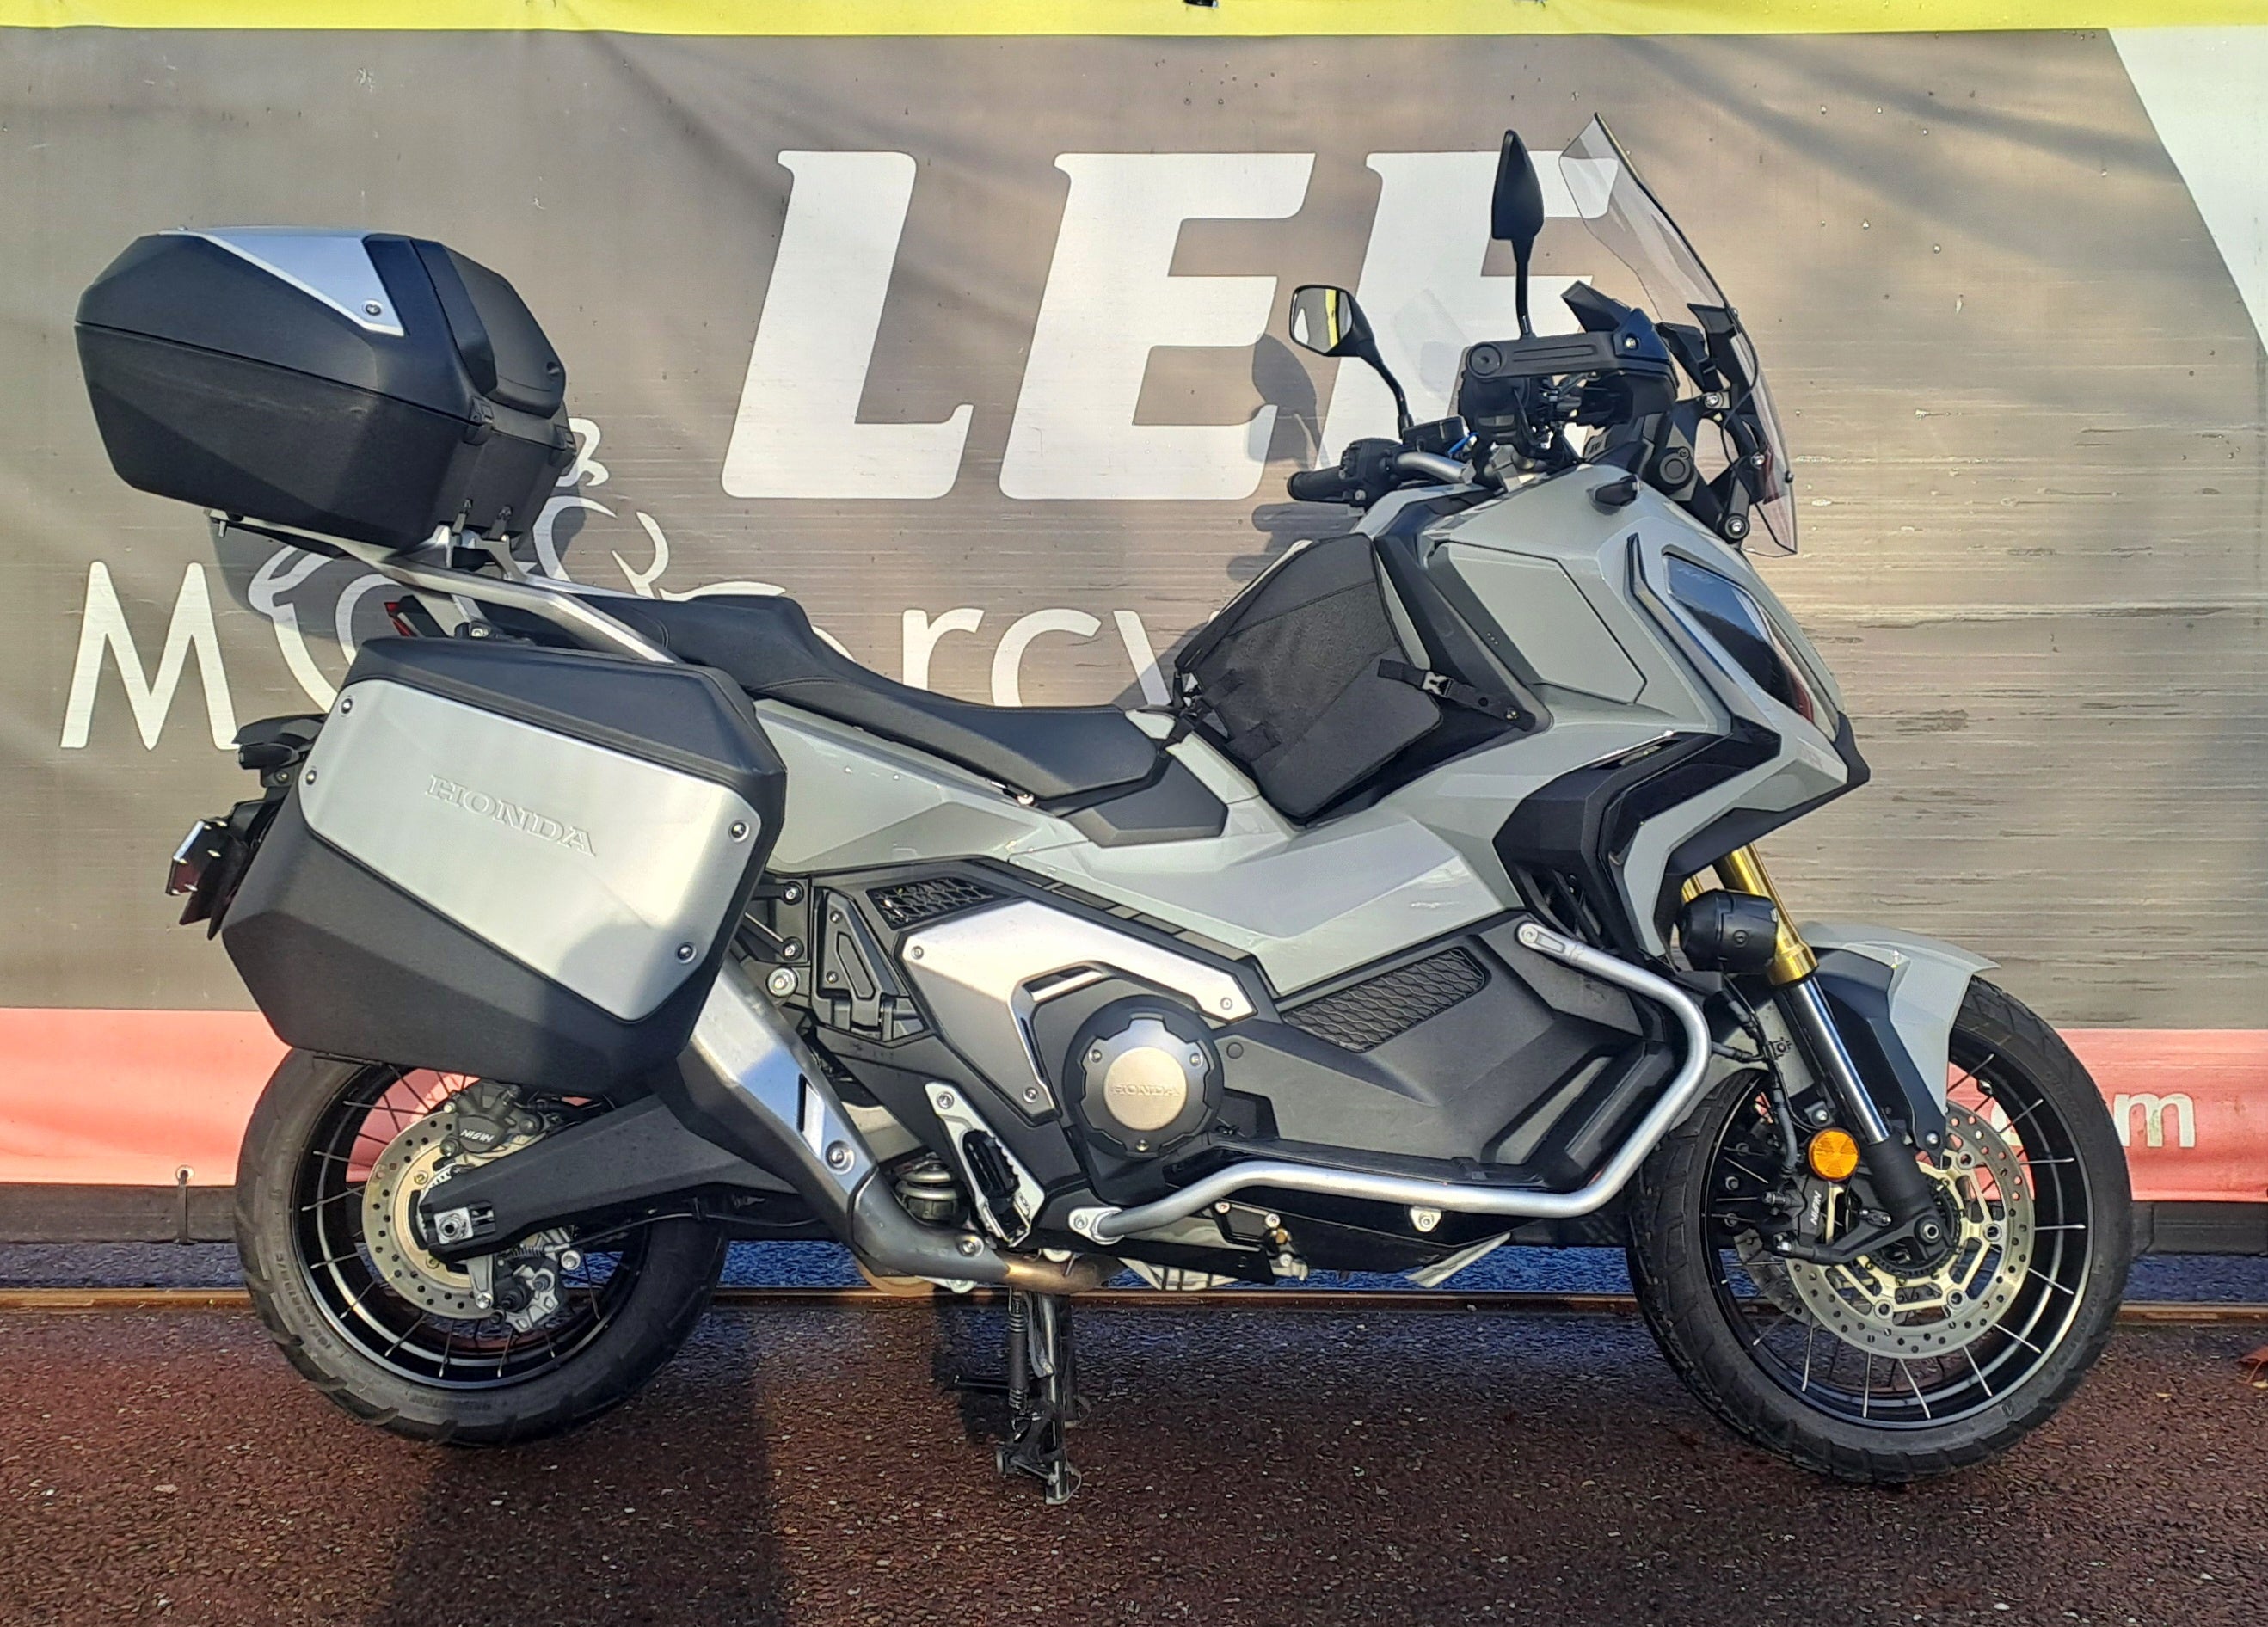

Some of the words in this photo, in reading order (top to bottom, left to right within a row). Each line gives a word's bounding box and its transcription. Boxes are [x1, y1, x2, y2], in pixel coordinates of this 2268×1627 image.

[721, 150, 1619, 500] LEE
[424, 774, 597, 857] HONDA
[1111, 1084, 1181, 1097] HONDA
